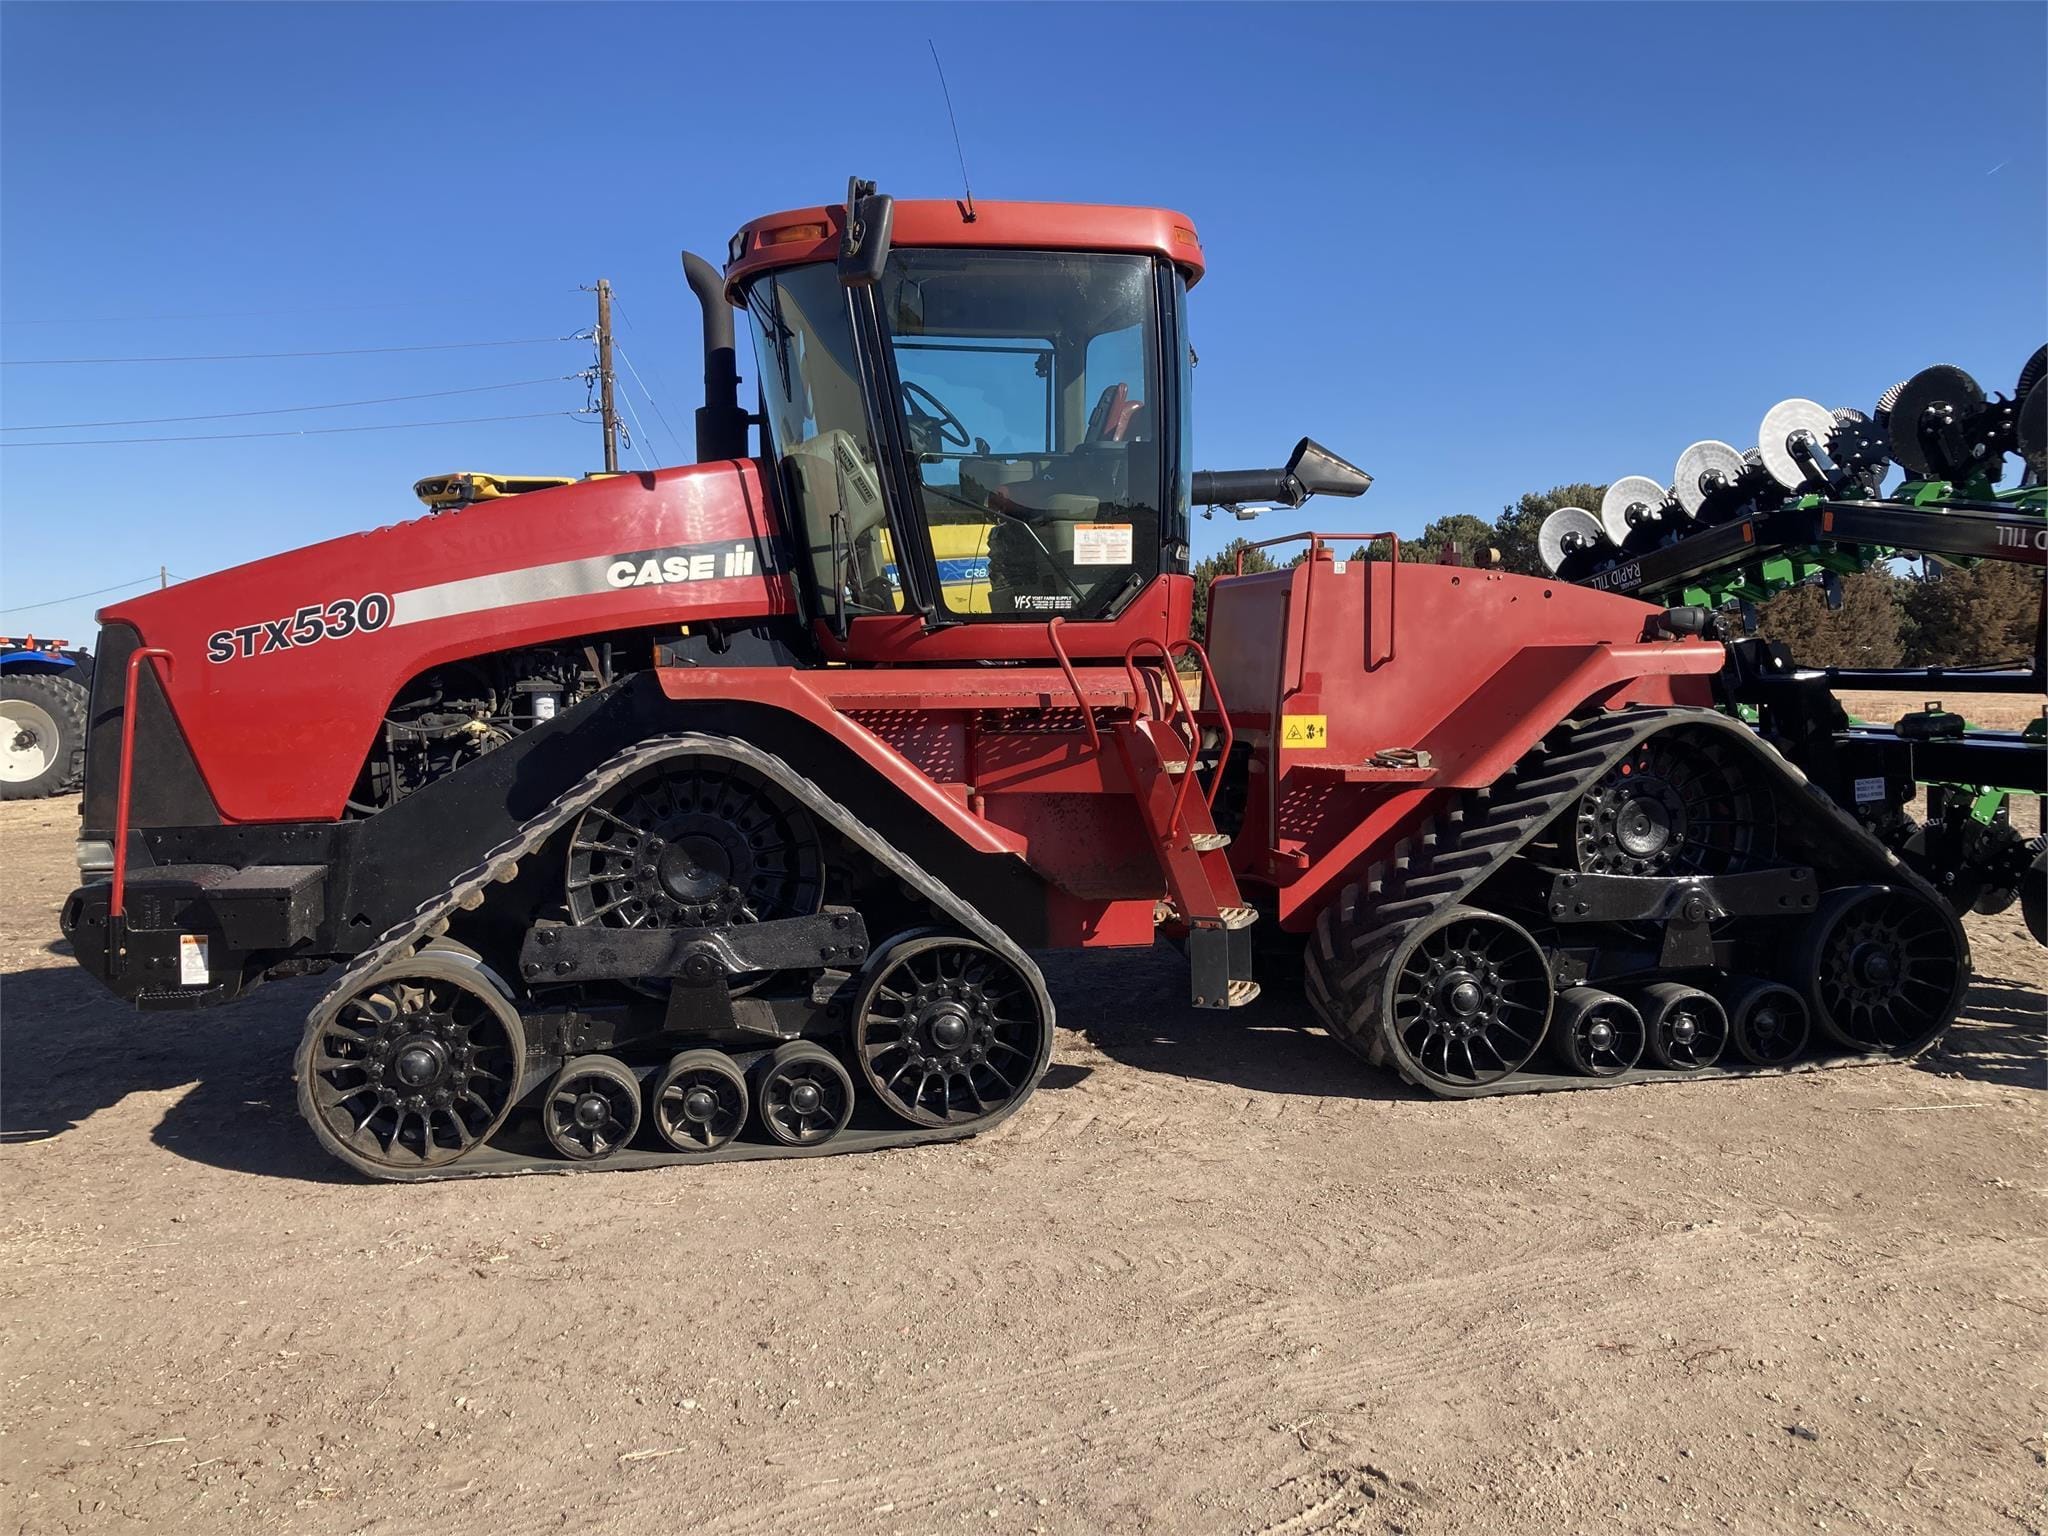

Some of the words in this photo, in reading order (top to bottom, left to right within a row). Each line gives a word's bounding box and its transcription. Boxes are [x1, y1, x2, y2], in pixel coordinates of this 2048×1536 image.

[1995, 525, 2029, 549] TILL
[606, 556, 715, 588] CASE
[1591, 573, 1611, 590] TILL
[1611, 562, 1642, 585] RAPID
[1014, 595, 1032, 609] YFS
[207, 592, 390, 664] STX530
